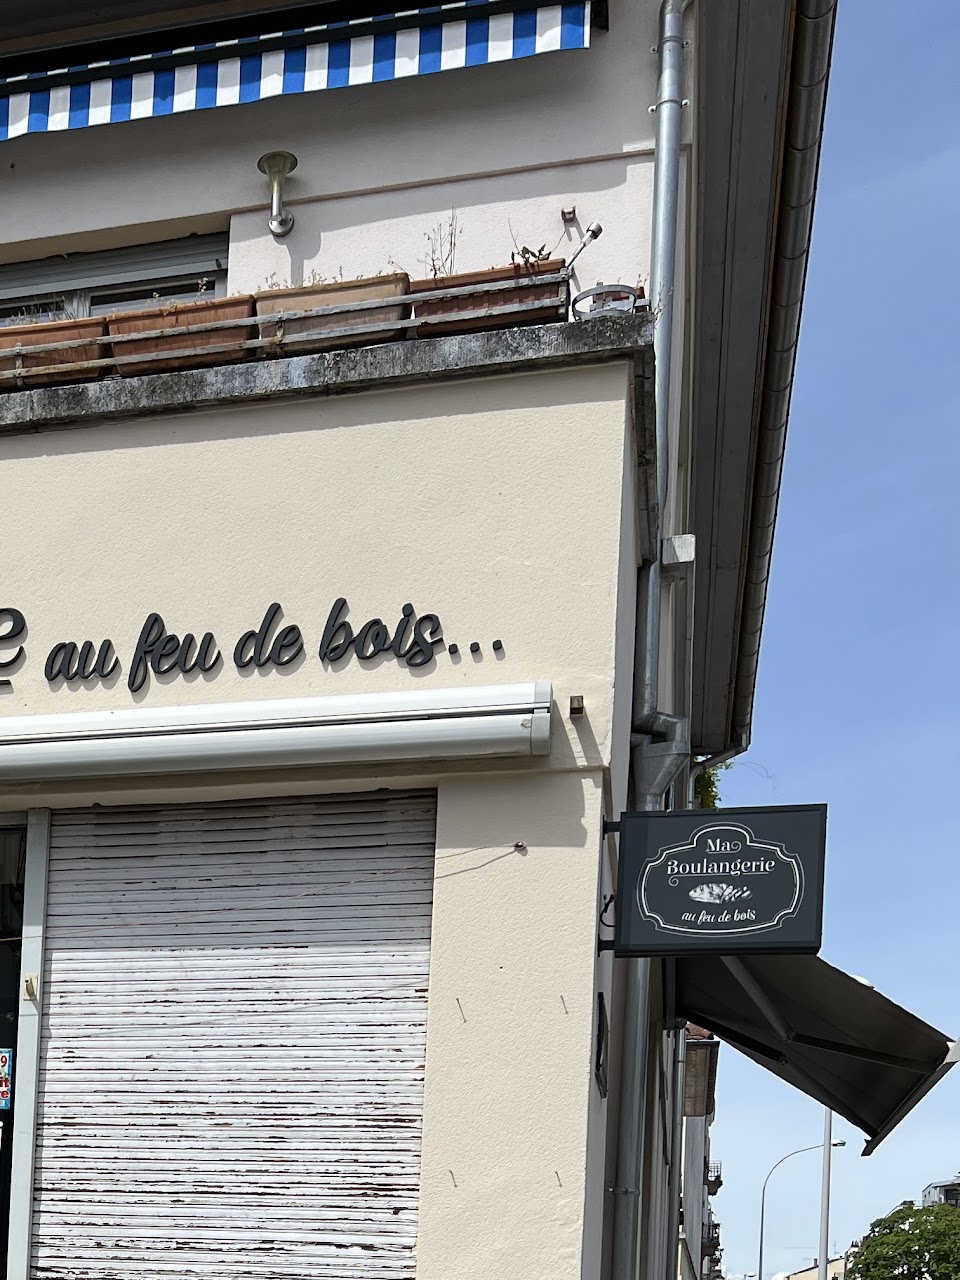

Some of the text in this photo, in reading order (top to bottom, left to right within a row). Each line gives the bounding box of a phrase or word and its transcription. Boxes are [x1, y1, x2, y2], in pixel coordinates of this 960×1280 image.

[44, 638, 119, 682] au
[128, 613, 222, 693] feu
[234, 602, 305, 671] de
[706, 838, 731, 852] Ma
[667, 858, 775, 876] Boulangerie
[681, 908, 757, 926] au feu de bois
